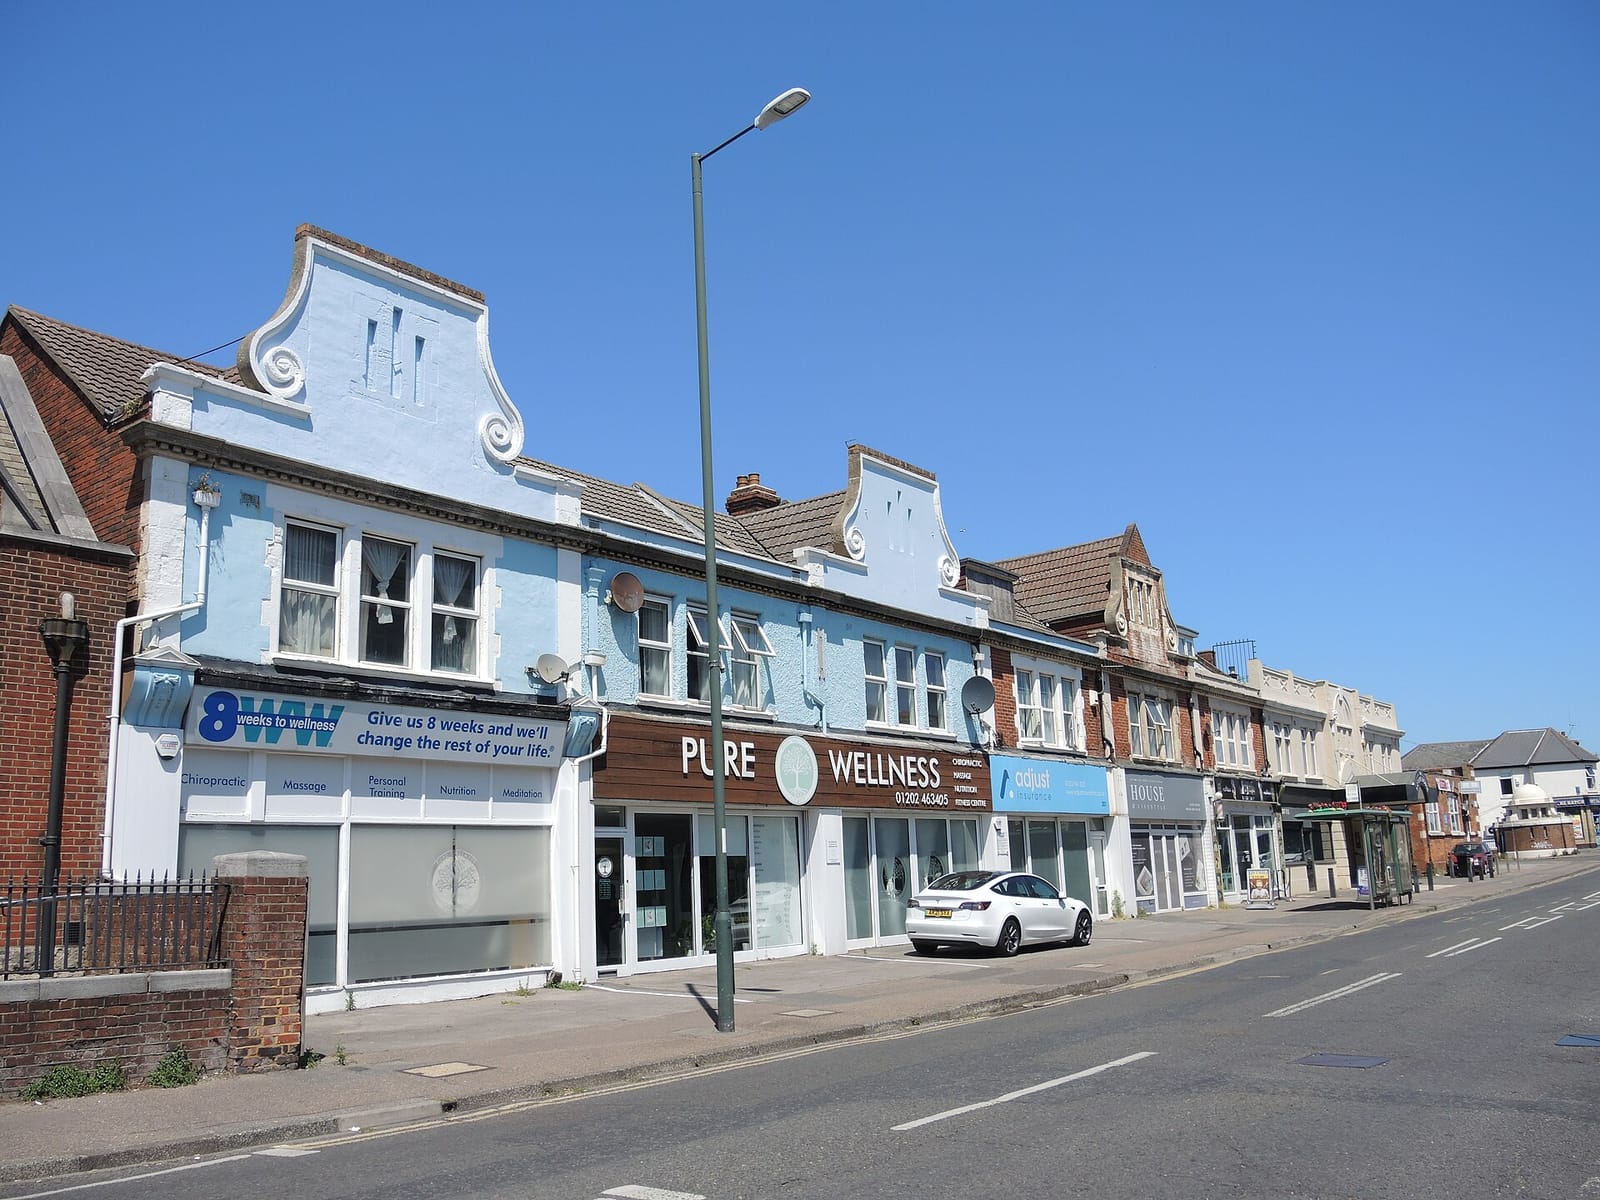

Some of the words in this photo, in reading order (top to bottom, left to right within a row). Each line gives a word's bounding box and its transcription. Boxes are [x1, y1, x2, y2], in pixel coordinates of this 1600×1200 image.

[237, 713, 272, 726] weeks
[275, 715, 287, 728] to
[289, 718, 336, 732] wellness
[367, 711, 402, 726] Give
[406, 717, 423, 728] us
[427, 716, 437, 729] 8
[440, 720, 484, 734] weeks
[487, 723, 514, 736] and
[517, 726, 548, 739] we'll
[357, 730, 412, 750] change
[417, 735, 441, 749] the
[444, 740, 472, 752] rest
[475, 740, 491, 753] of
[492, 744, 524, 757] your
[682, 736, 756, 778] PURE
[828, 749, 941, 789] WELLNESS
[181, 773, 246, 787] Chiropractic
[282, 780, 327, 793] Massage
[368, 775, 406, 786] Personal
[1015, 767, 1050, 792] adjust
[369, 788, 405, 800] Training
[440, 785, 476, 796] Nutrition
[502, 788, 543, 799] Meditation
[1016, 790, 1052, 801] insurance
[1130, 784, 1165, 802] HOUSE
[895, 791, 920, 804] 01202
[921, 792, 949, 806] 463405
